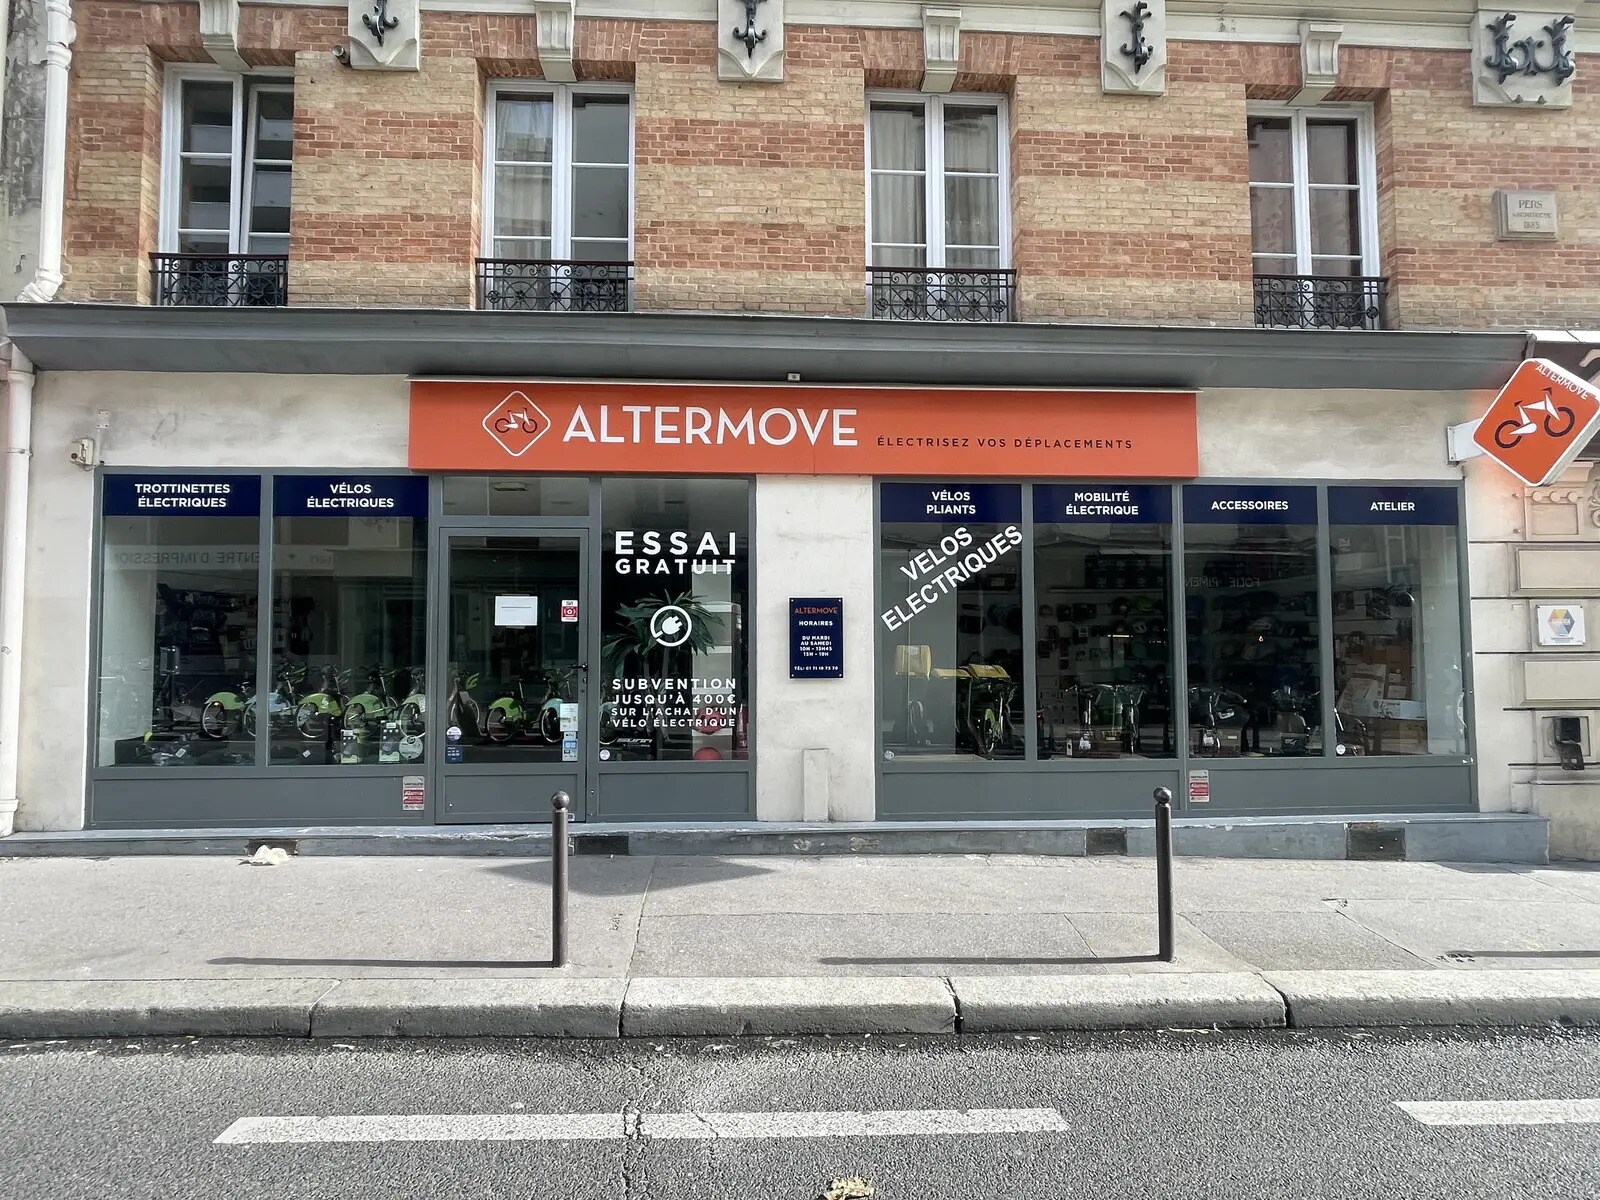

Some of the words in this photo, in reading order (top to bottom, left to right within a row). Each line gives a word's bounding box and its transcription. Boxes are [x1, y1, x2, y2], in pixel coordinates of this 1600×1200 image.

[1518, 199, 1543, 209] PERS
[1535, 364, 1588, 400] ALTERMOVE
[562, 404, 858, 446] ALTERMOVE
[877, 434, 970, 447] ÉLECTRISEZ
[977, 438, 1006, 448] VOS
[1014, 436, 1133, 449] DÉPLACEMENTS
[134, 483, 231, 495] TROTTINETTES
[329, 481, 372, 494] VÉLOS
[931, 489, 971, 501] VÉLOS
[1074, 490, 1130, 502] MOBILITÉ
[137, 495, 227, 508] ÉLECTRIQUES
[306, 495, 395, 509] ÉLECTRIQUES
[1211, 500, 1289, 510] ACCESSOIRES
[1370, 501, 1416, 512] ATELIER
[926, 504, 976, 514] PLIANTS
[1065, 503, 1139, 516] ÉLECTRIQUE
[615, 531, 736, 555] ESSAI
[900, 526, 973, 581] VELOS
[615, 558, 736, 575] GRATUIT
[881, 525, 1023, 632] ELECTRIQUES
[612, 678, 736, 690] SUBVENTION
[692, 694, 736, 704] 400€
[611, 707, 636, 716] SUR
[613, 717, 647, 727] VÉLO
[653, 717, 736, 727] ÉLECTRIQUE
